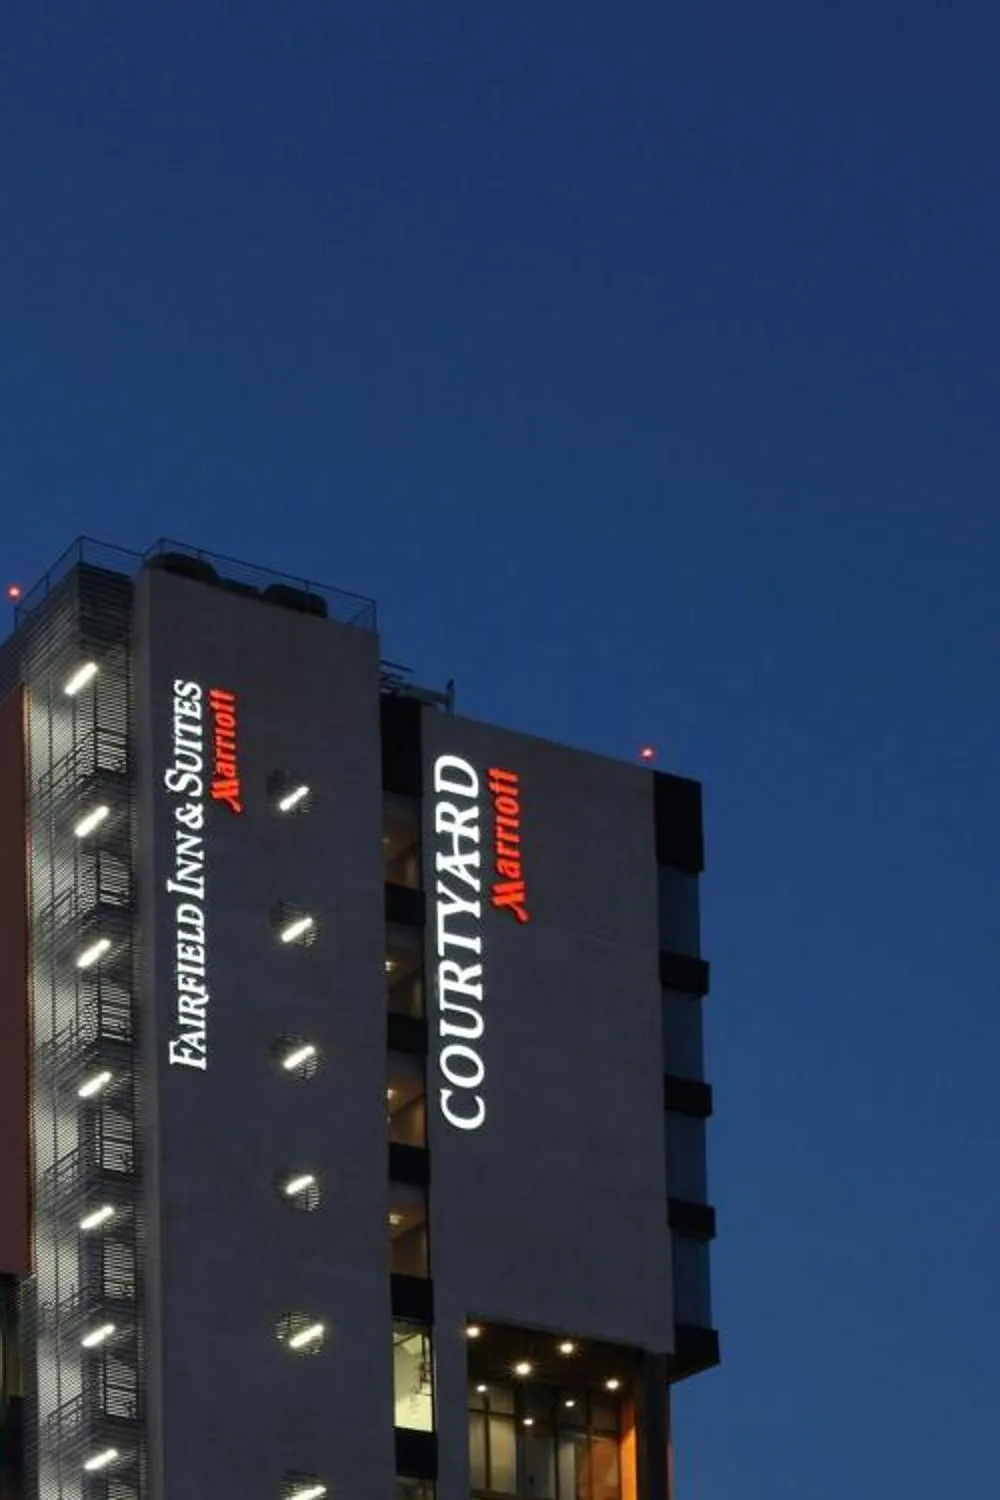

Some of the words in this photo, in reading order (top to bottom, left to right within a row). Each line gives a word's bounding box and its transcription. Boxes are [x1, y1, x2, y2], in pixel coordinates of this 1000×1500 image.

[163, 679, 204, 797] SUITES
[208, 687, 242, 813] Marriott
[166, 831, 205, 900] INN
[174, 802, 205, 830] &
[487, 767, 529, 922] Marriott
[169, 903, 209, 1070] FAIRFIELD
[433, 754, 486, 1130] COURTYARD
